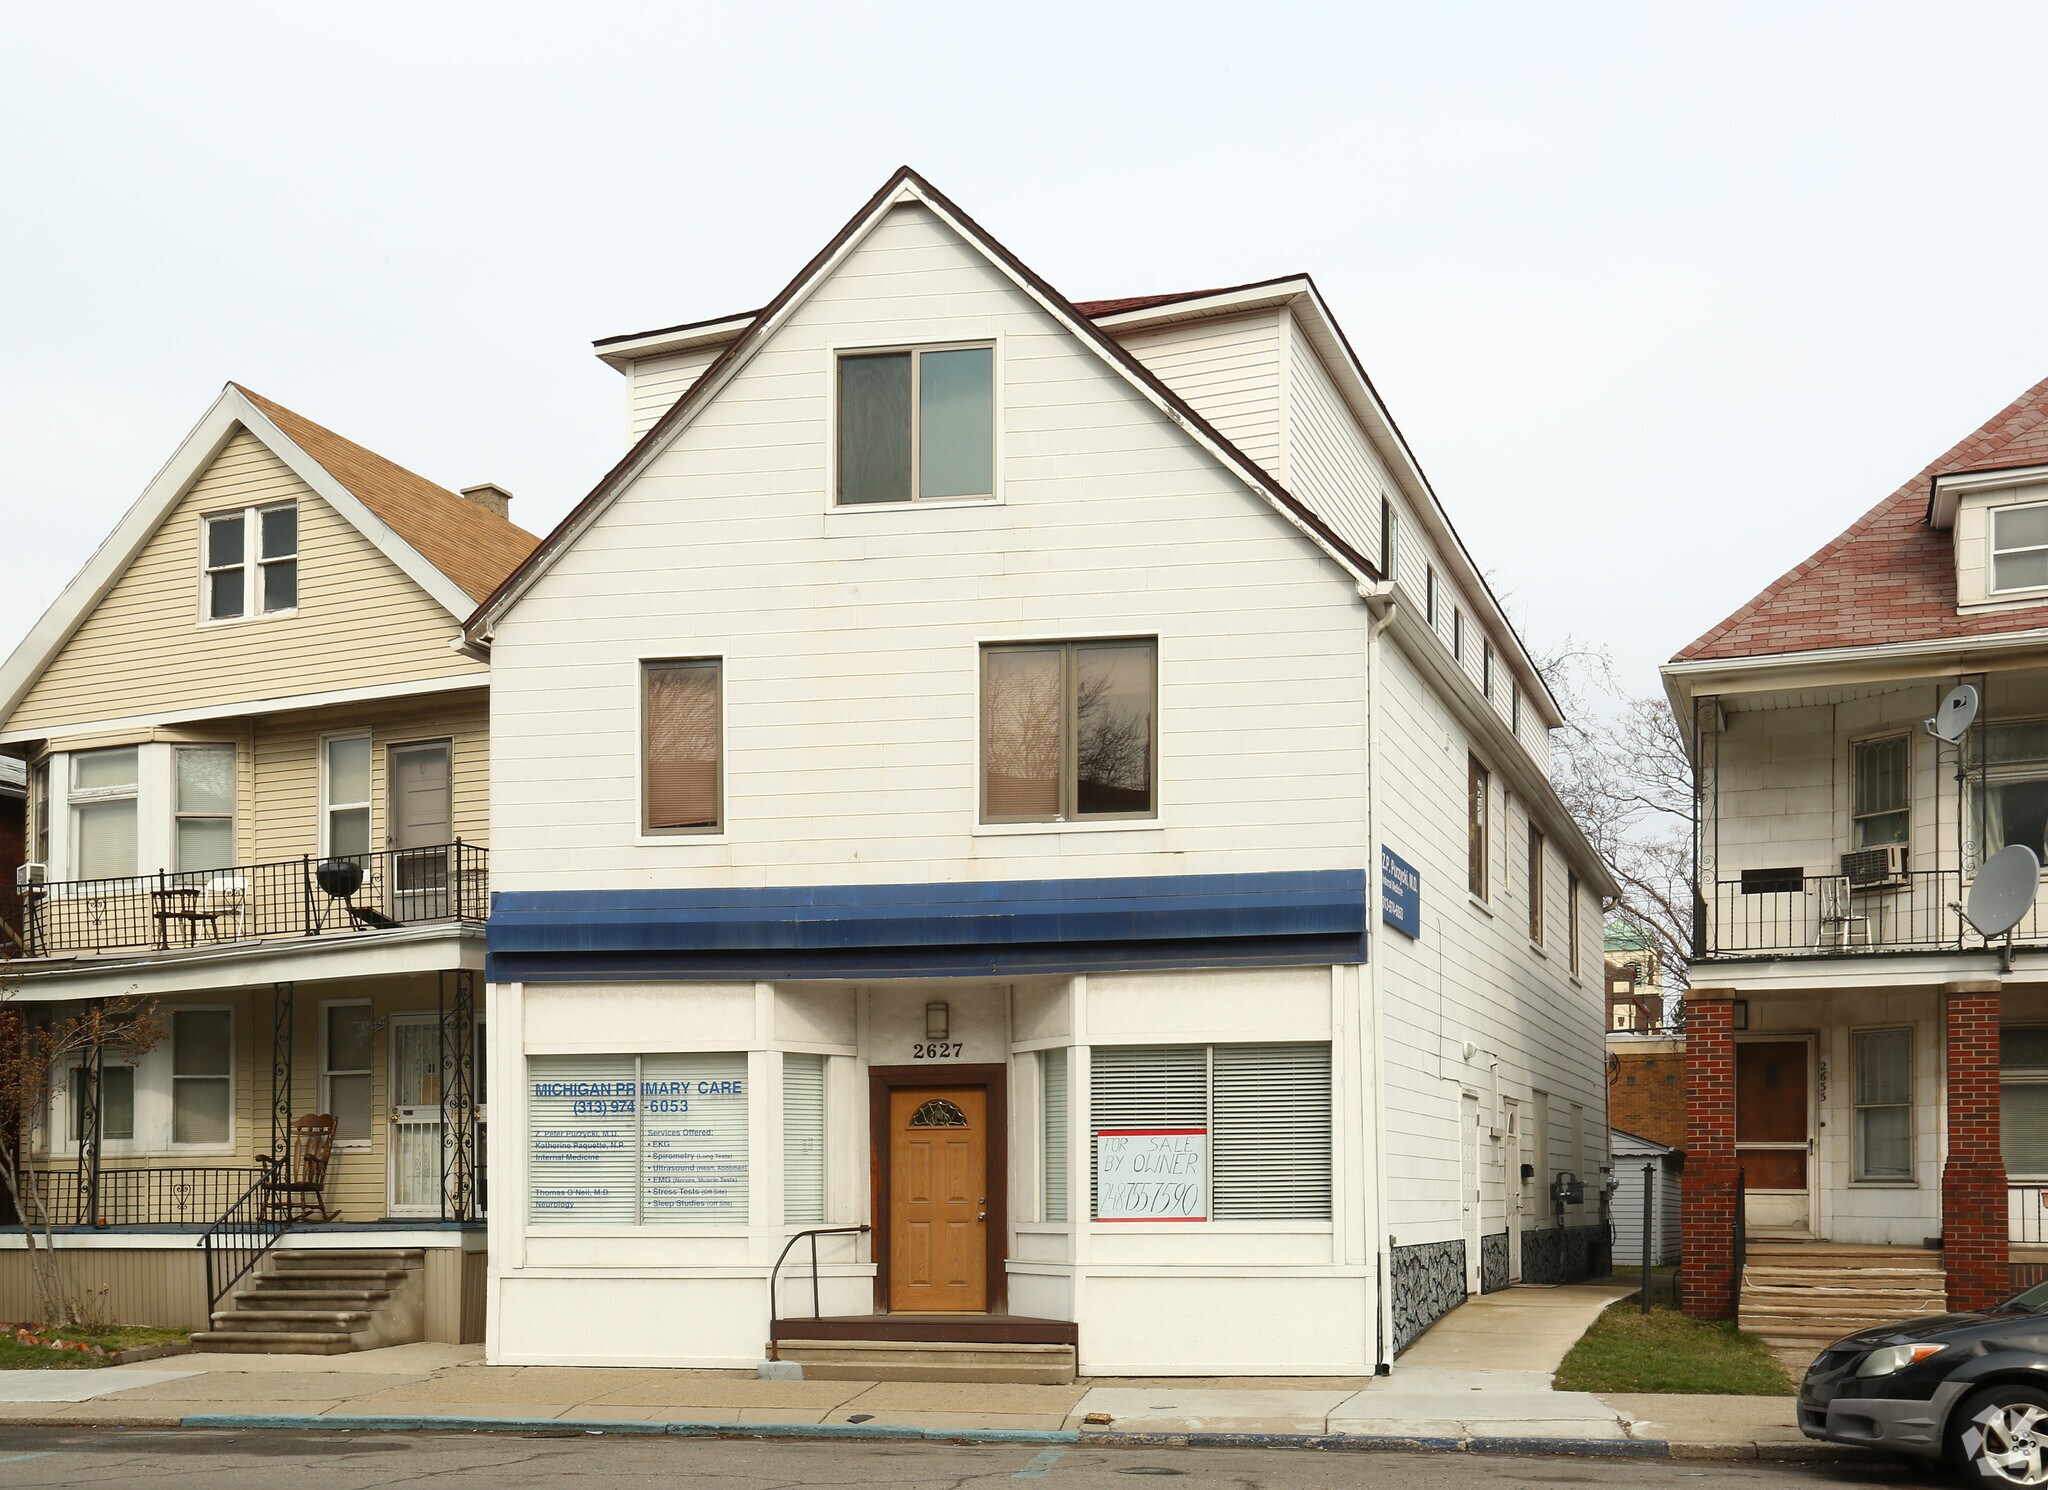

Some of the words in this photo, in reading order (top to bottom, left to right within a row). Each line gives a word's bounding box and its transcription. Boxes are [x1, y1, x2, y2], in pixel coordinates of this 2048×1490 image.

[913, 1043, 963, 1059] 2627
[535, 1083, 611, 1097] MICHIGAN
[698, 1081, 742, 1094] CARE
[573, 1100, 607, 1116] (313)
[1104, 1137, 1129, 1152] FOR
[1147, 1136, 1196, 1152] SALE
[1104, 1154, 1125, 1172] BY
[1133, 1153, 1199, 1174] OWNER
[535, 1201, 574, 1209] Neurology
[652, 1200, 674, 1208] Sleep
